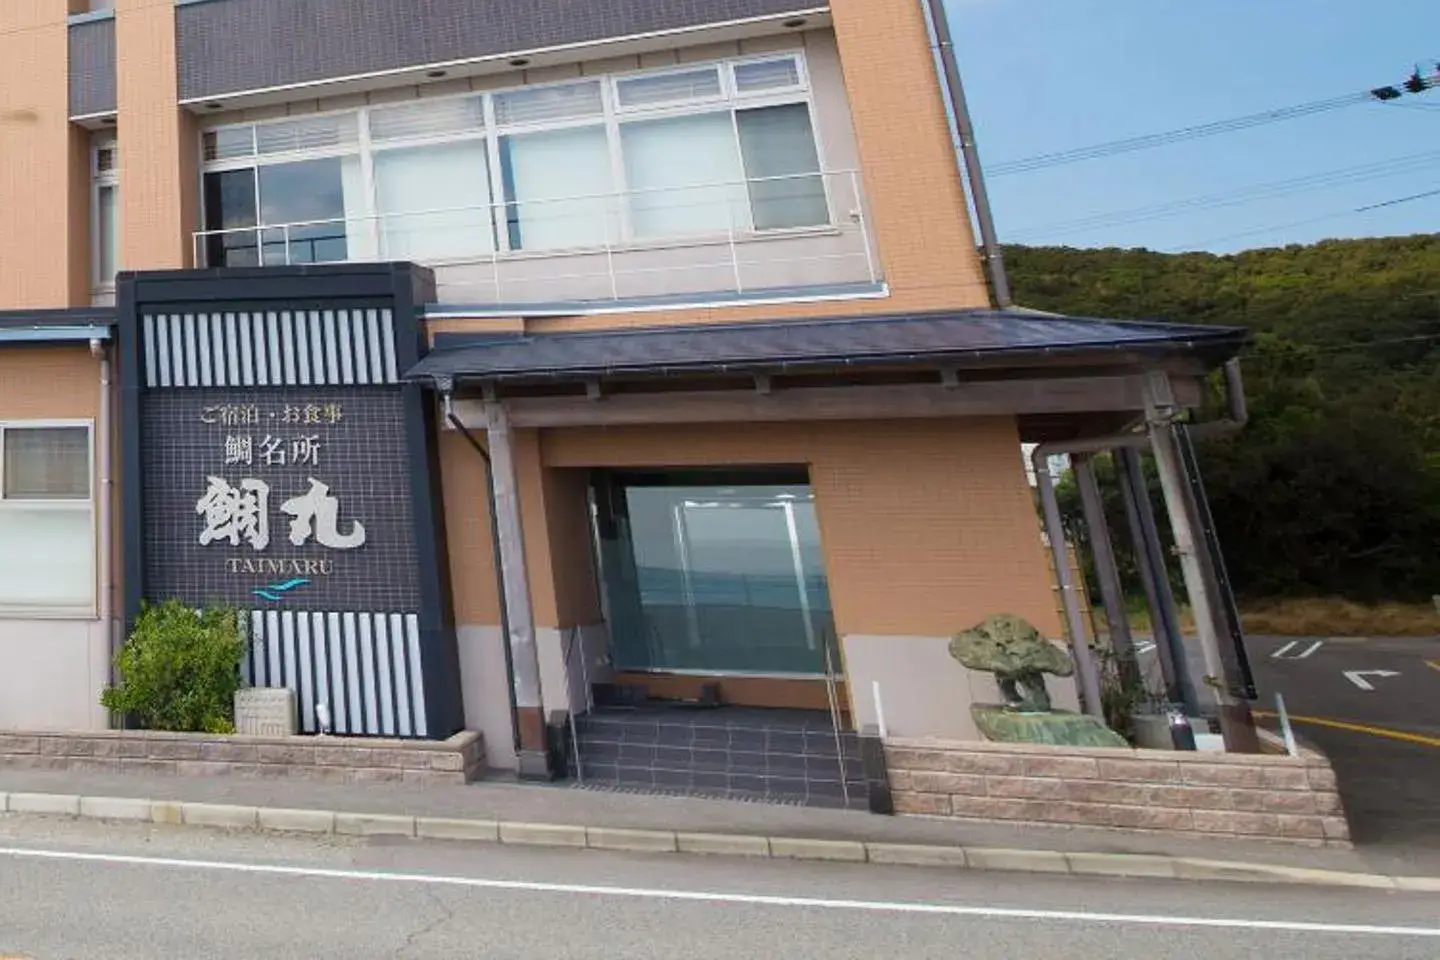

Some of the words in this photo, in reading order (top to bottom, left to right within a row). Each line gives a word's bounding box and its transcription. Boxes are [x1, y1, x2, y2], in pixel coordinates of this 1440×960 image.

[224, 434, 321, 465] 鯛名所
[196, 476, 365, 550] 鯛丸
[227, 558, 332, 574] TAIMARU
